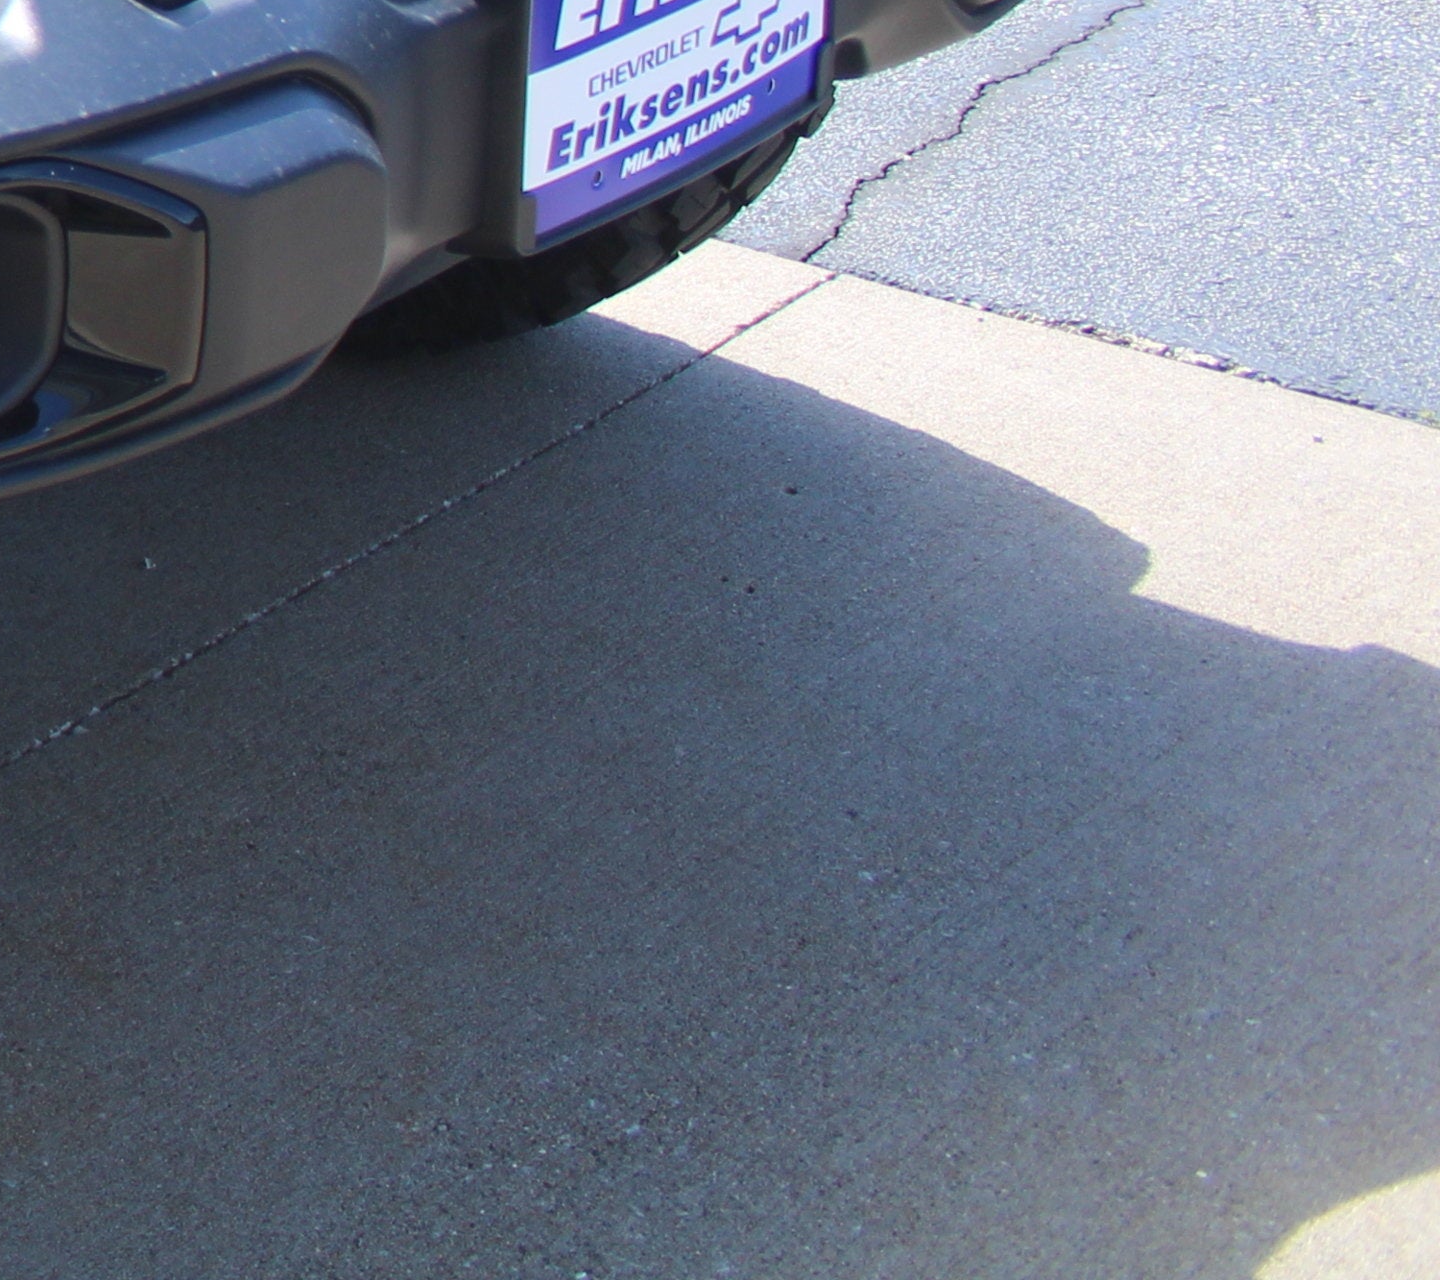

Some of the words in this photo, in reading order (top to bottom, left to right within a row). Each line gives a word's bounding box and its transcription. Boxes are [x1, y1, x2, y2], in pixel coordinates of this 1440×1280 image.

[545, 10, 809, 173] Eriksens.com
[588, 25, 705, 98] CHEVROLET
[620, 132, 681, 179] MILAN,
[684, 93, 752, 148] ILLINOIS
